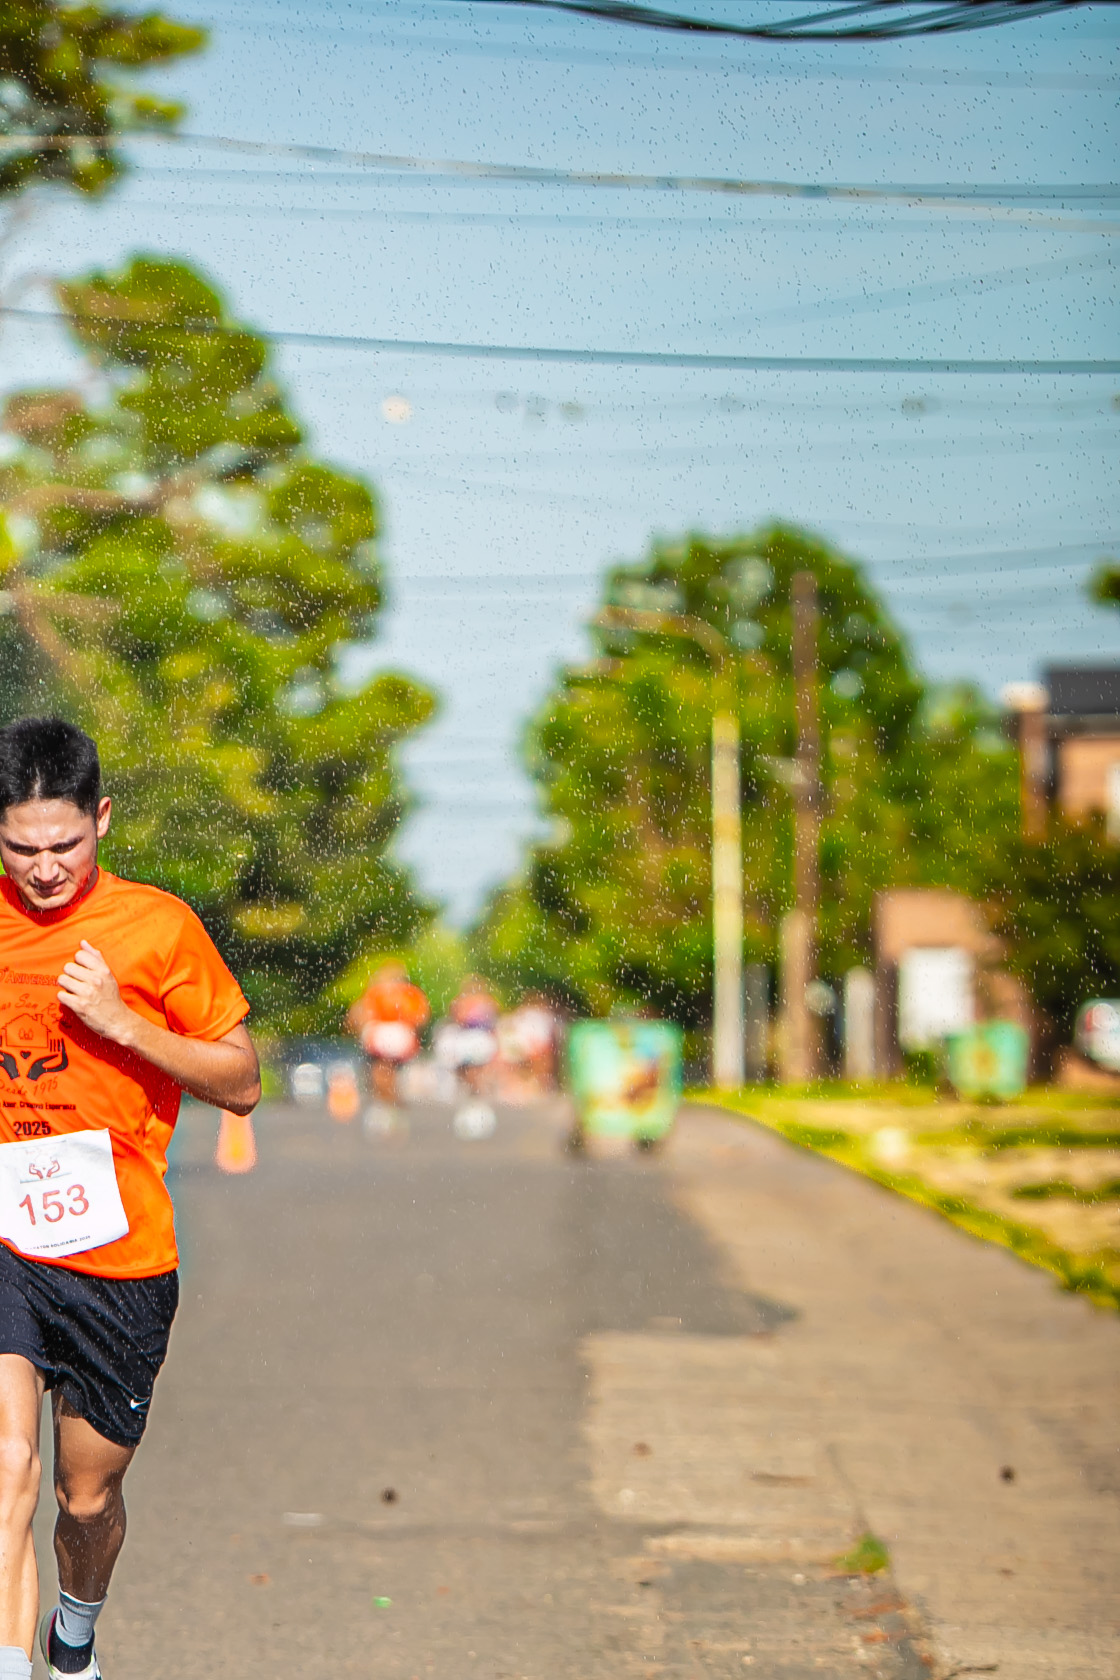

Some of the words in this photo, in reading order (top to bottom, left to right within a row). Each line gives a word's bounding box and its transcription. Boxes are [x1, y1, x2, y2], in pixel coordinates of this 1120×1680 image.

[6, 970, 59, 987] ANIVERSA
[34, 1076, 58, 1096] 1975
[14, 1121, 51, 1136] 2025
[19, 1184, 89, 1226] 153
